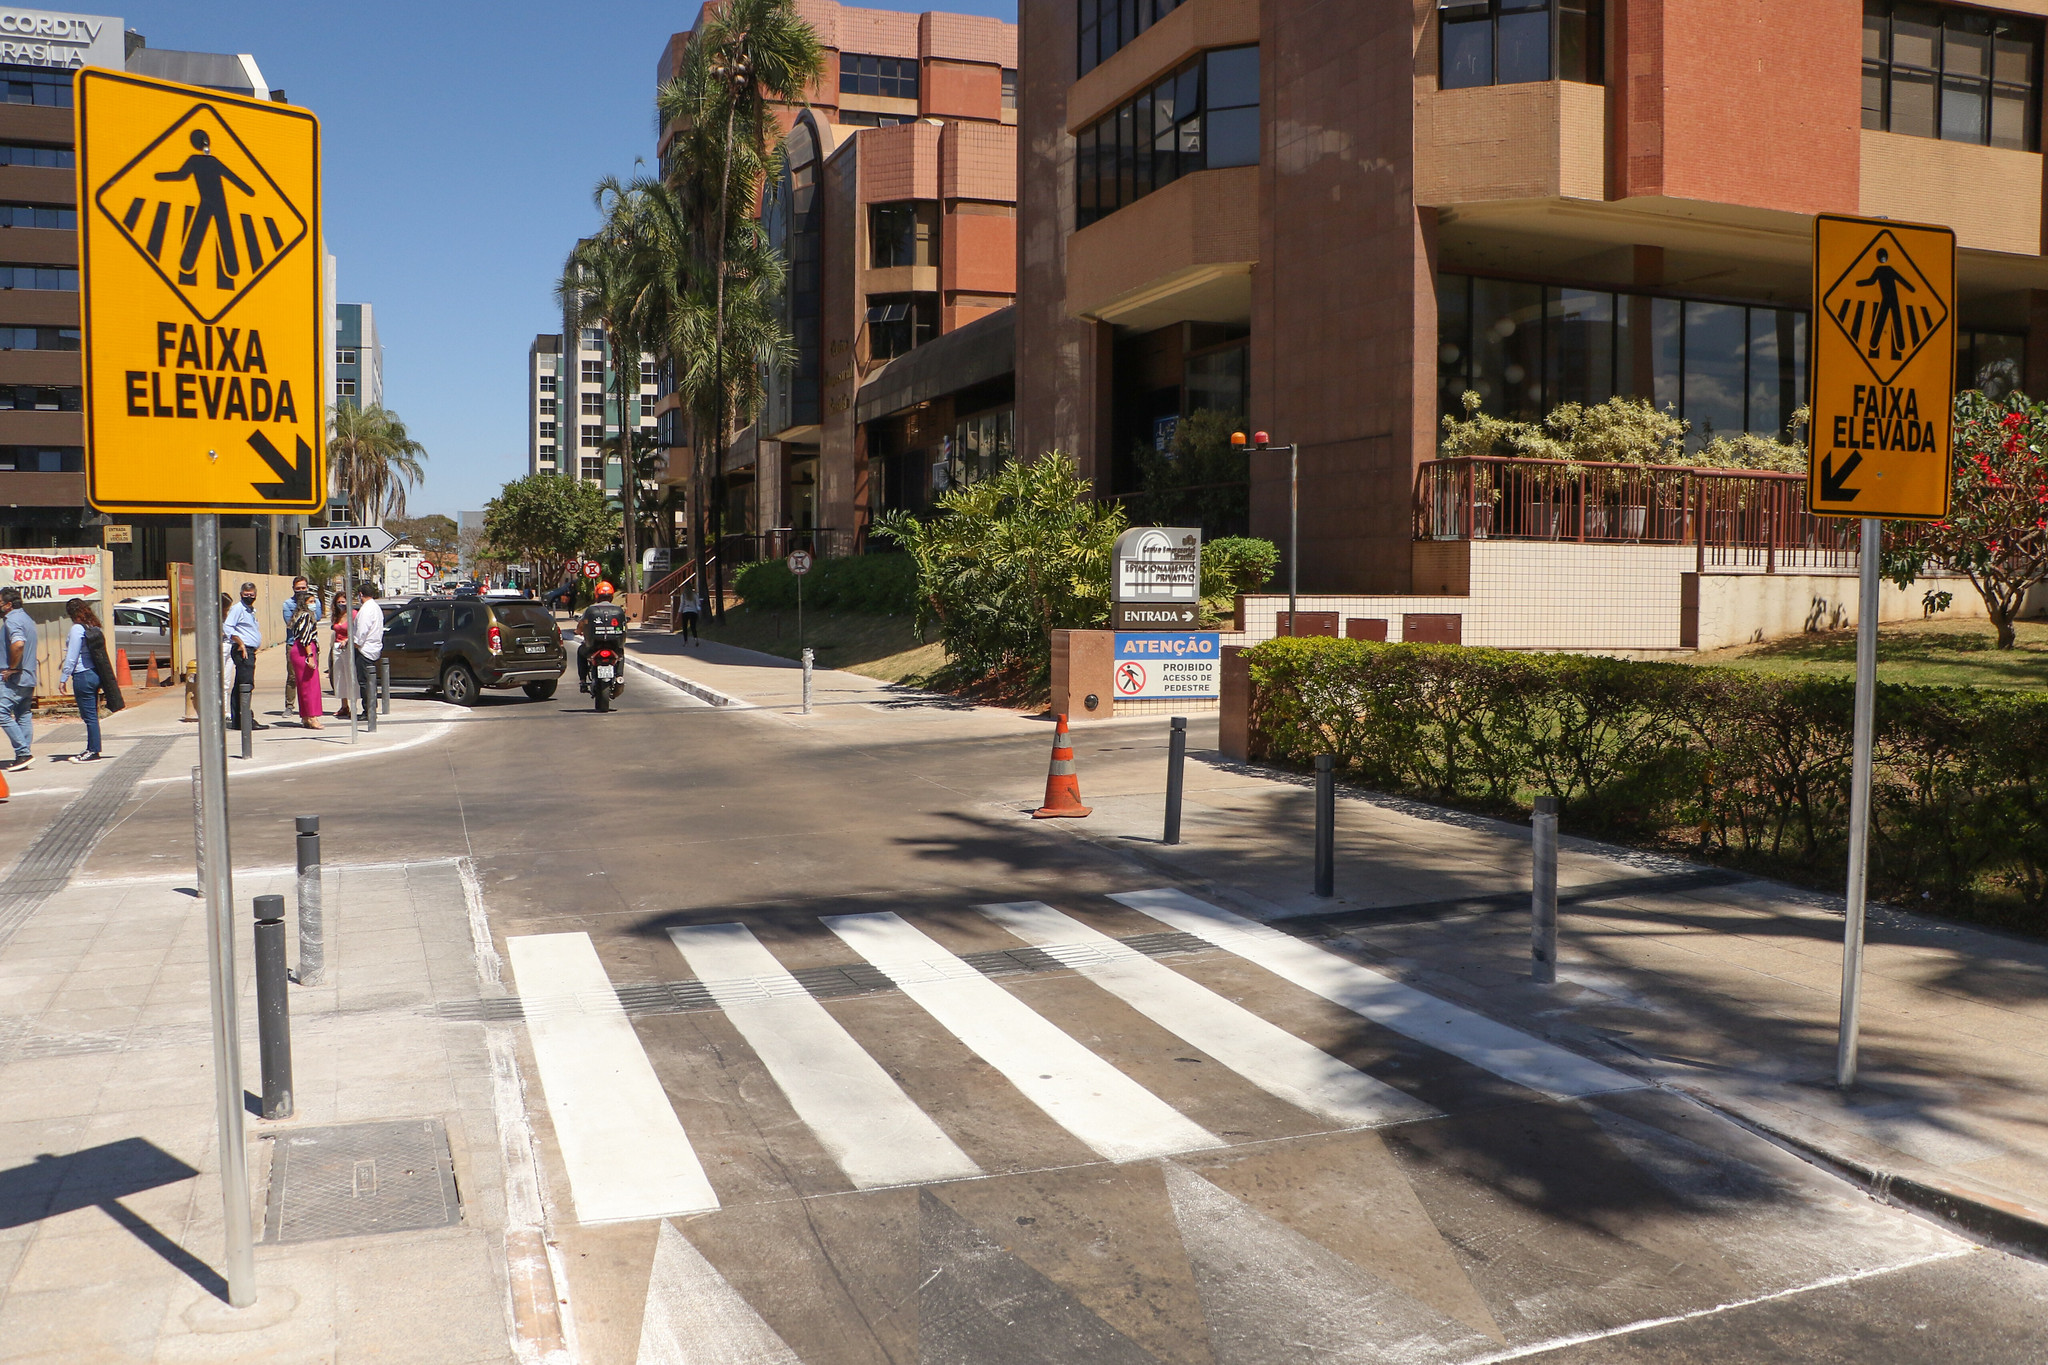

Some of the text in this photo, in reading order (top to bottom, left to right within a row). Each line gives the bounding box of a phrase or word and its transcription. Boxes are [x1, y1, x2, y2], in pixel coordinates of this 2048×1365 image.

[0, 41, 84, 66] RASÍLIA
[157, 321, 268, 374] FAIXA
[125, 370, 298, 424] ELEVADA
[1853, 384, 1919, 420] FAIXA
[1833, 415, 1936, 453] ELEVADA
[320, 532, 372, 550] SAÍDA
[14, 567, 86, 582] ROTATIVO
[1125, 564, 1195, 573] ESTACIONAMENTO
[1156, 574, 1195, 582] PRIVATIVO
[1124, 610, 1178, 622] ENTRADA
[1123, 636, 1212, 656] ATENÇÃO
[1163, 663, 1213, 672] PROIBIDO
[1163, 674, 1212, 682] ACESSO DE
[1164, 684, 1210, 692] PEDESTRE
